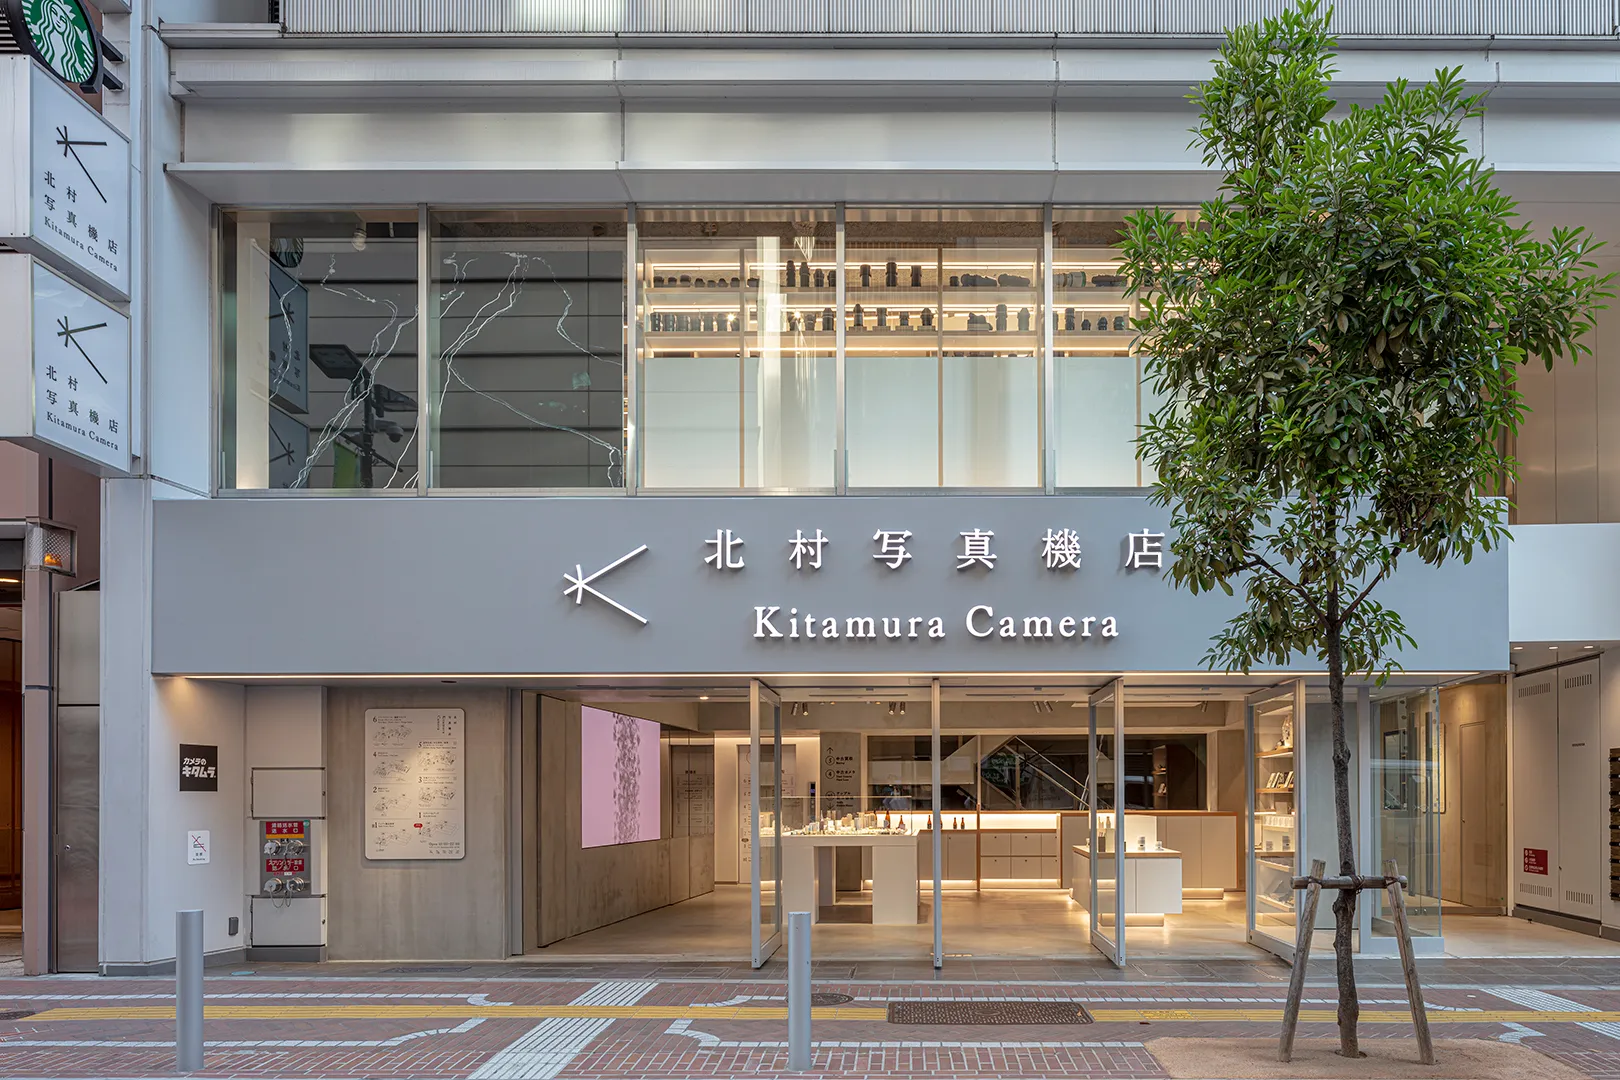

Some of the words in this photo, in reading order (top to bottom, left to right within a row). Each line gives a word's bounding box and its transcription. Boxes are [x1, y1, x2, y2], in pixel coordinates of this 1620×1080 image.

[44, 170, 77, 203] 北村
[44, 194, 118, 255] 写真機店
[44, 216, 84, 250] Kitamura
[87, 246, 118, 272] Camera
[46, 365, 78, 391] 北村
[46, 389, 119, 434] 写真機店
[46, 411, 86, 437] Kitamura
[88, 430, 119, 452] Camera
[704, 528, 1166, 570] 北村写真機店
[753, 606, 946, 639] Kitamura
[965, 604, 1120, 638] Camera
[182, 765, 216, 778] キタムラ
[183, 757, 207, 766] カメラの
